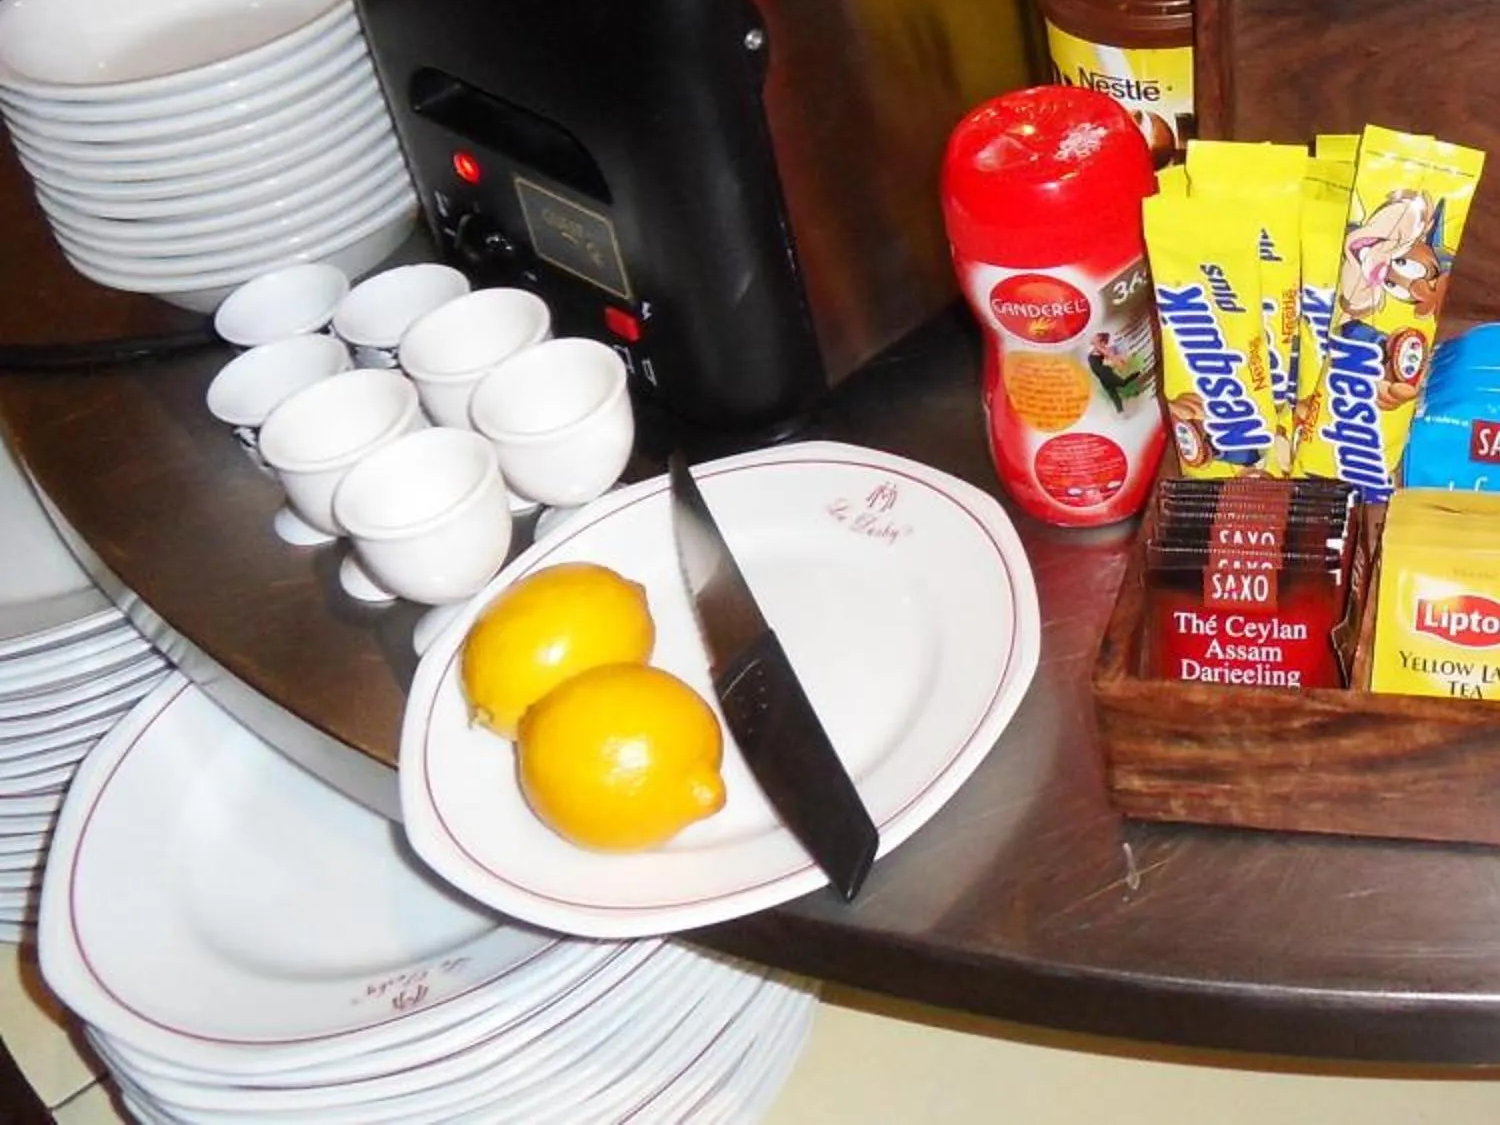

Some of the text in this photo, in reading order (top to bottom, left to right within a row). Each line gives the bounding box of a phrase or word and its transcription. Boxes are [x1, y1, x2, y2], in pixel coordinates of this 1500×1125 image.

[1200, 263, 1247, 313] plus
[1158, 286, 1272, 447] Nesquik
[1212, 573, 1269, 602] SAXO
[1173, 611, 1308, 644] Thé Ceylan
[1205, 638, 1282, 662] Assam
[1399, 650, 1475, 677] YELLOW
[1180, 658, 1301, 688] Darjeeling
[1448, 680, 1483, 700] TEA
